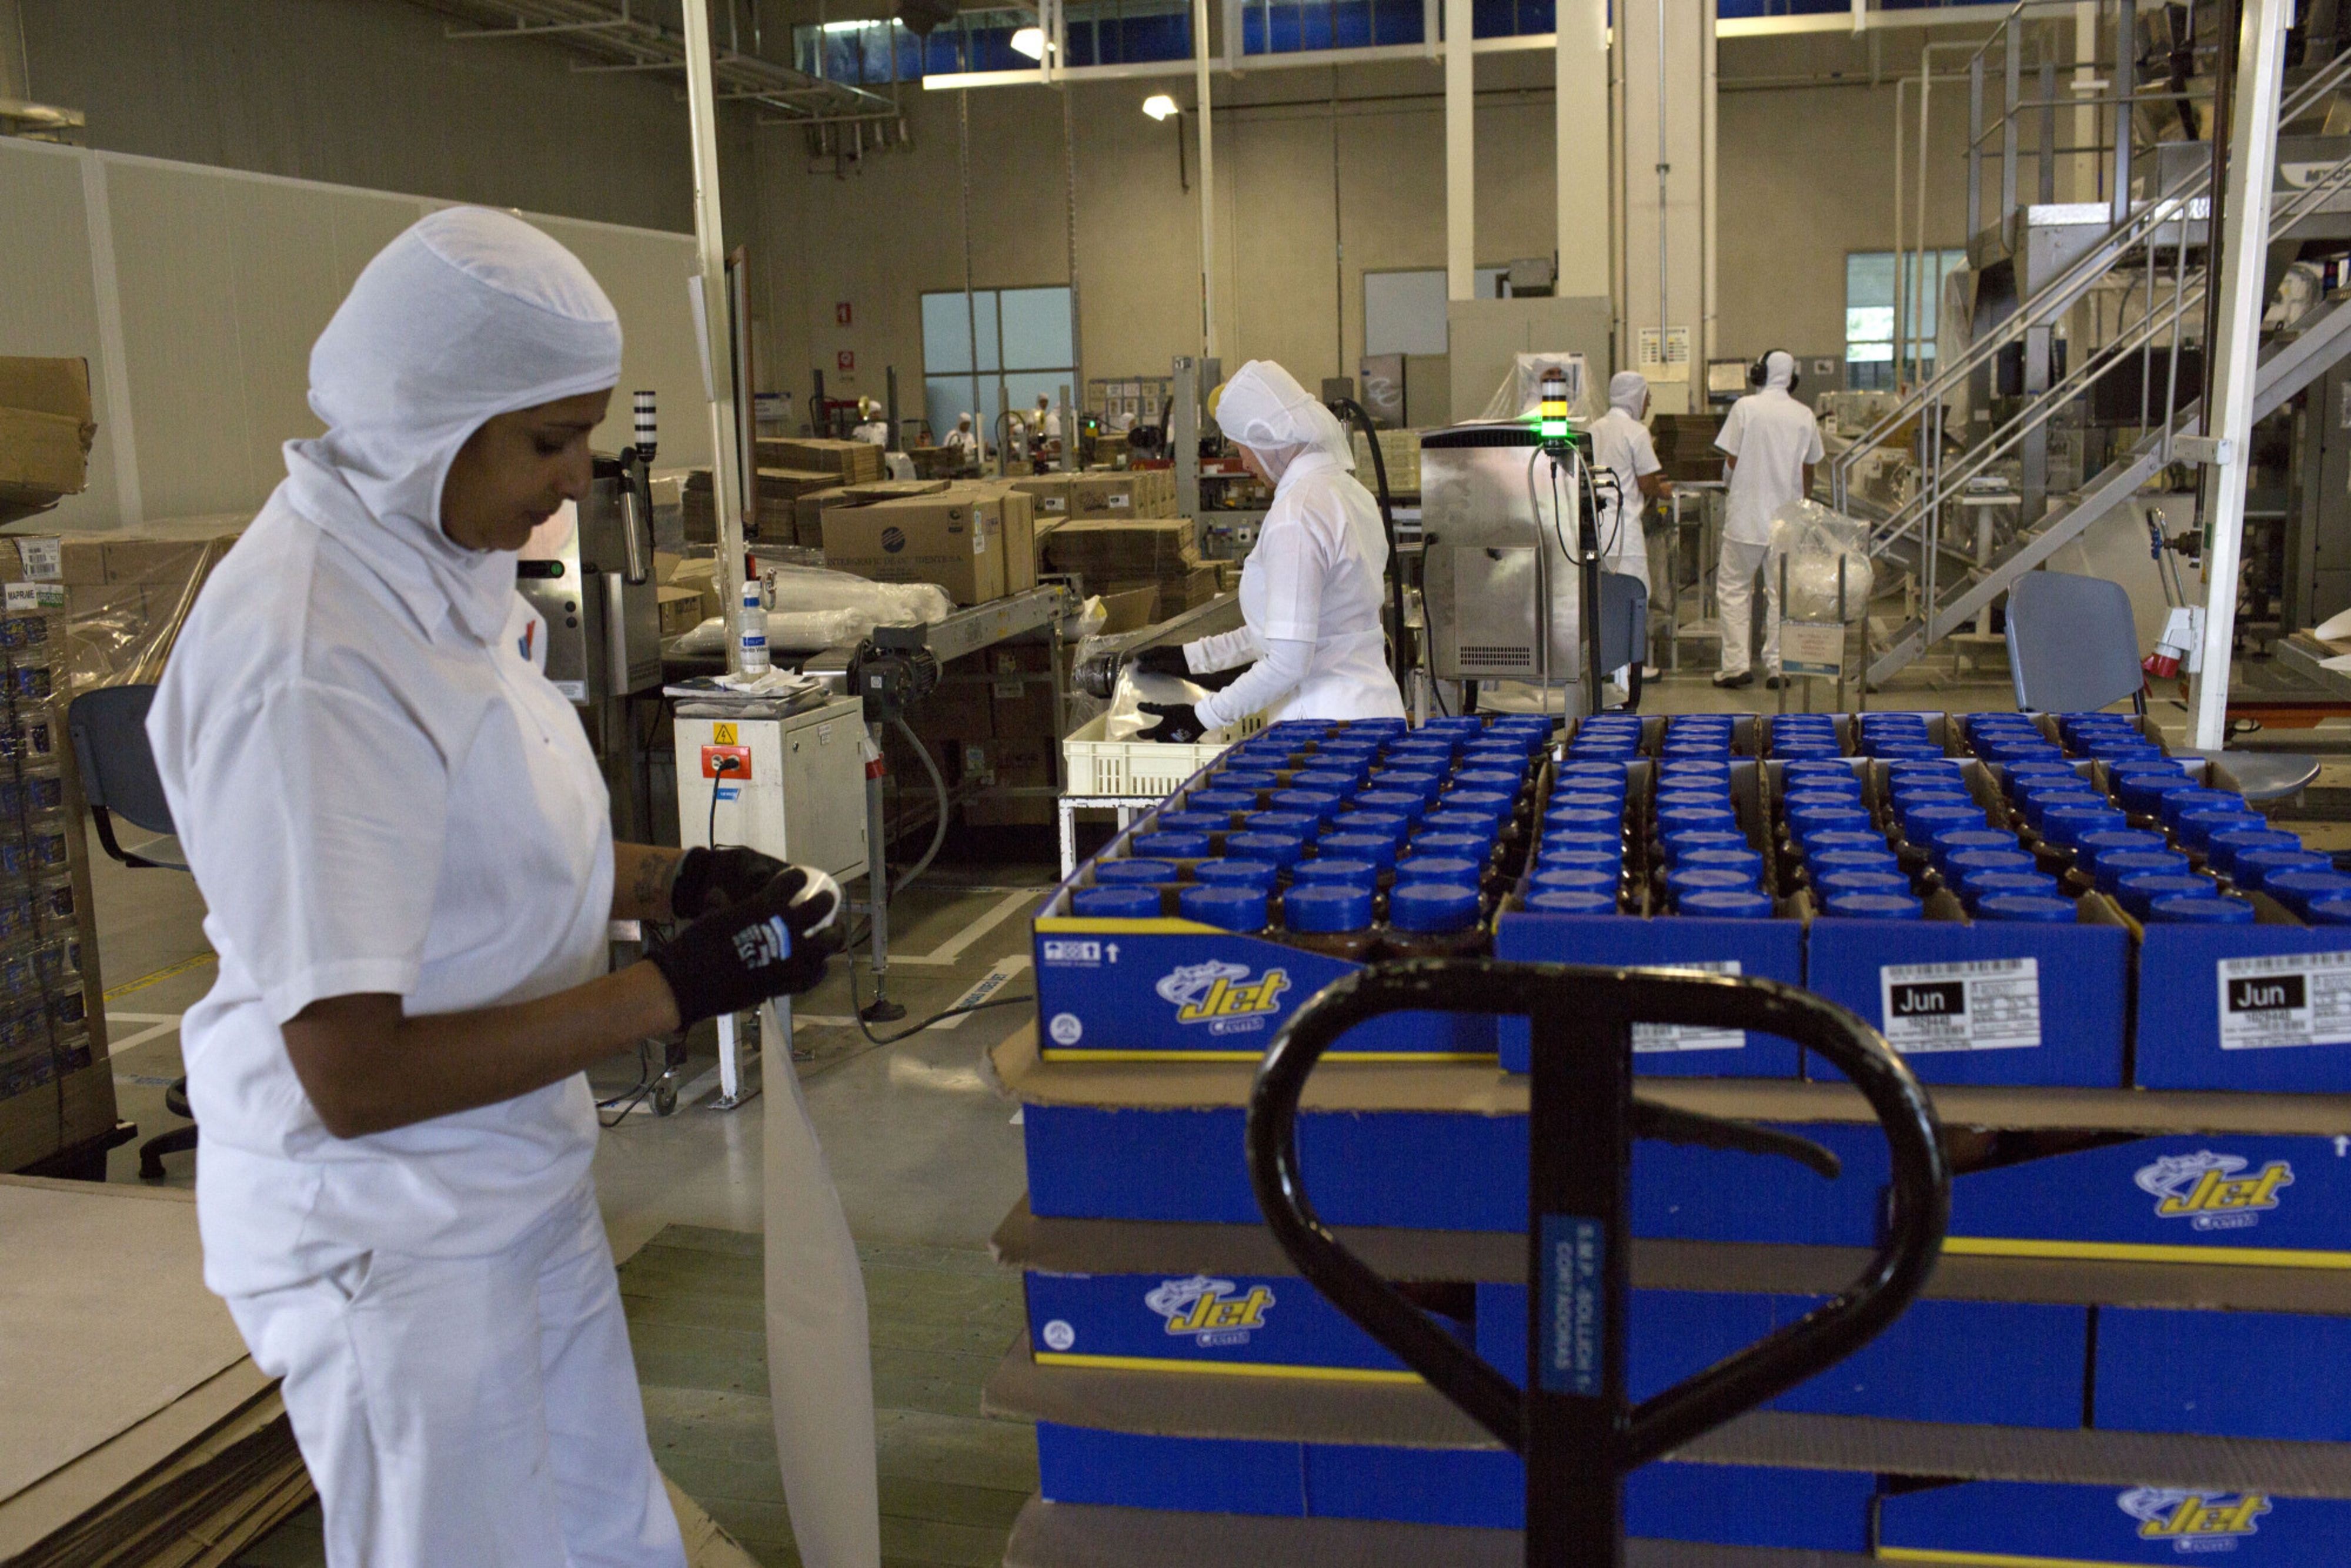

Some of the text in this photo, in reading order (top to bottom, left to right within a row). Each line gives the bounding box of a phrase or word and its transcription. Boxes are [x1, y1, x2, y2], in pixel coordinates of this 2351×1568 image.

[1178, 970, 1288, 1021] Jet
[1899, 988, 1946, 1013] Jun
[2236, 981, 2285, 1008] Jun
[2159, 1164, 2292, 1215] Jet
[1167, 1288, 1274, 1332] Jet
[2141, 1495, 2268, 1536] Jet
